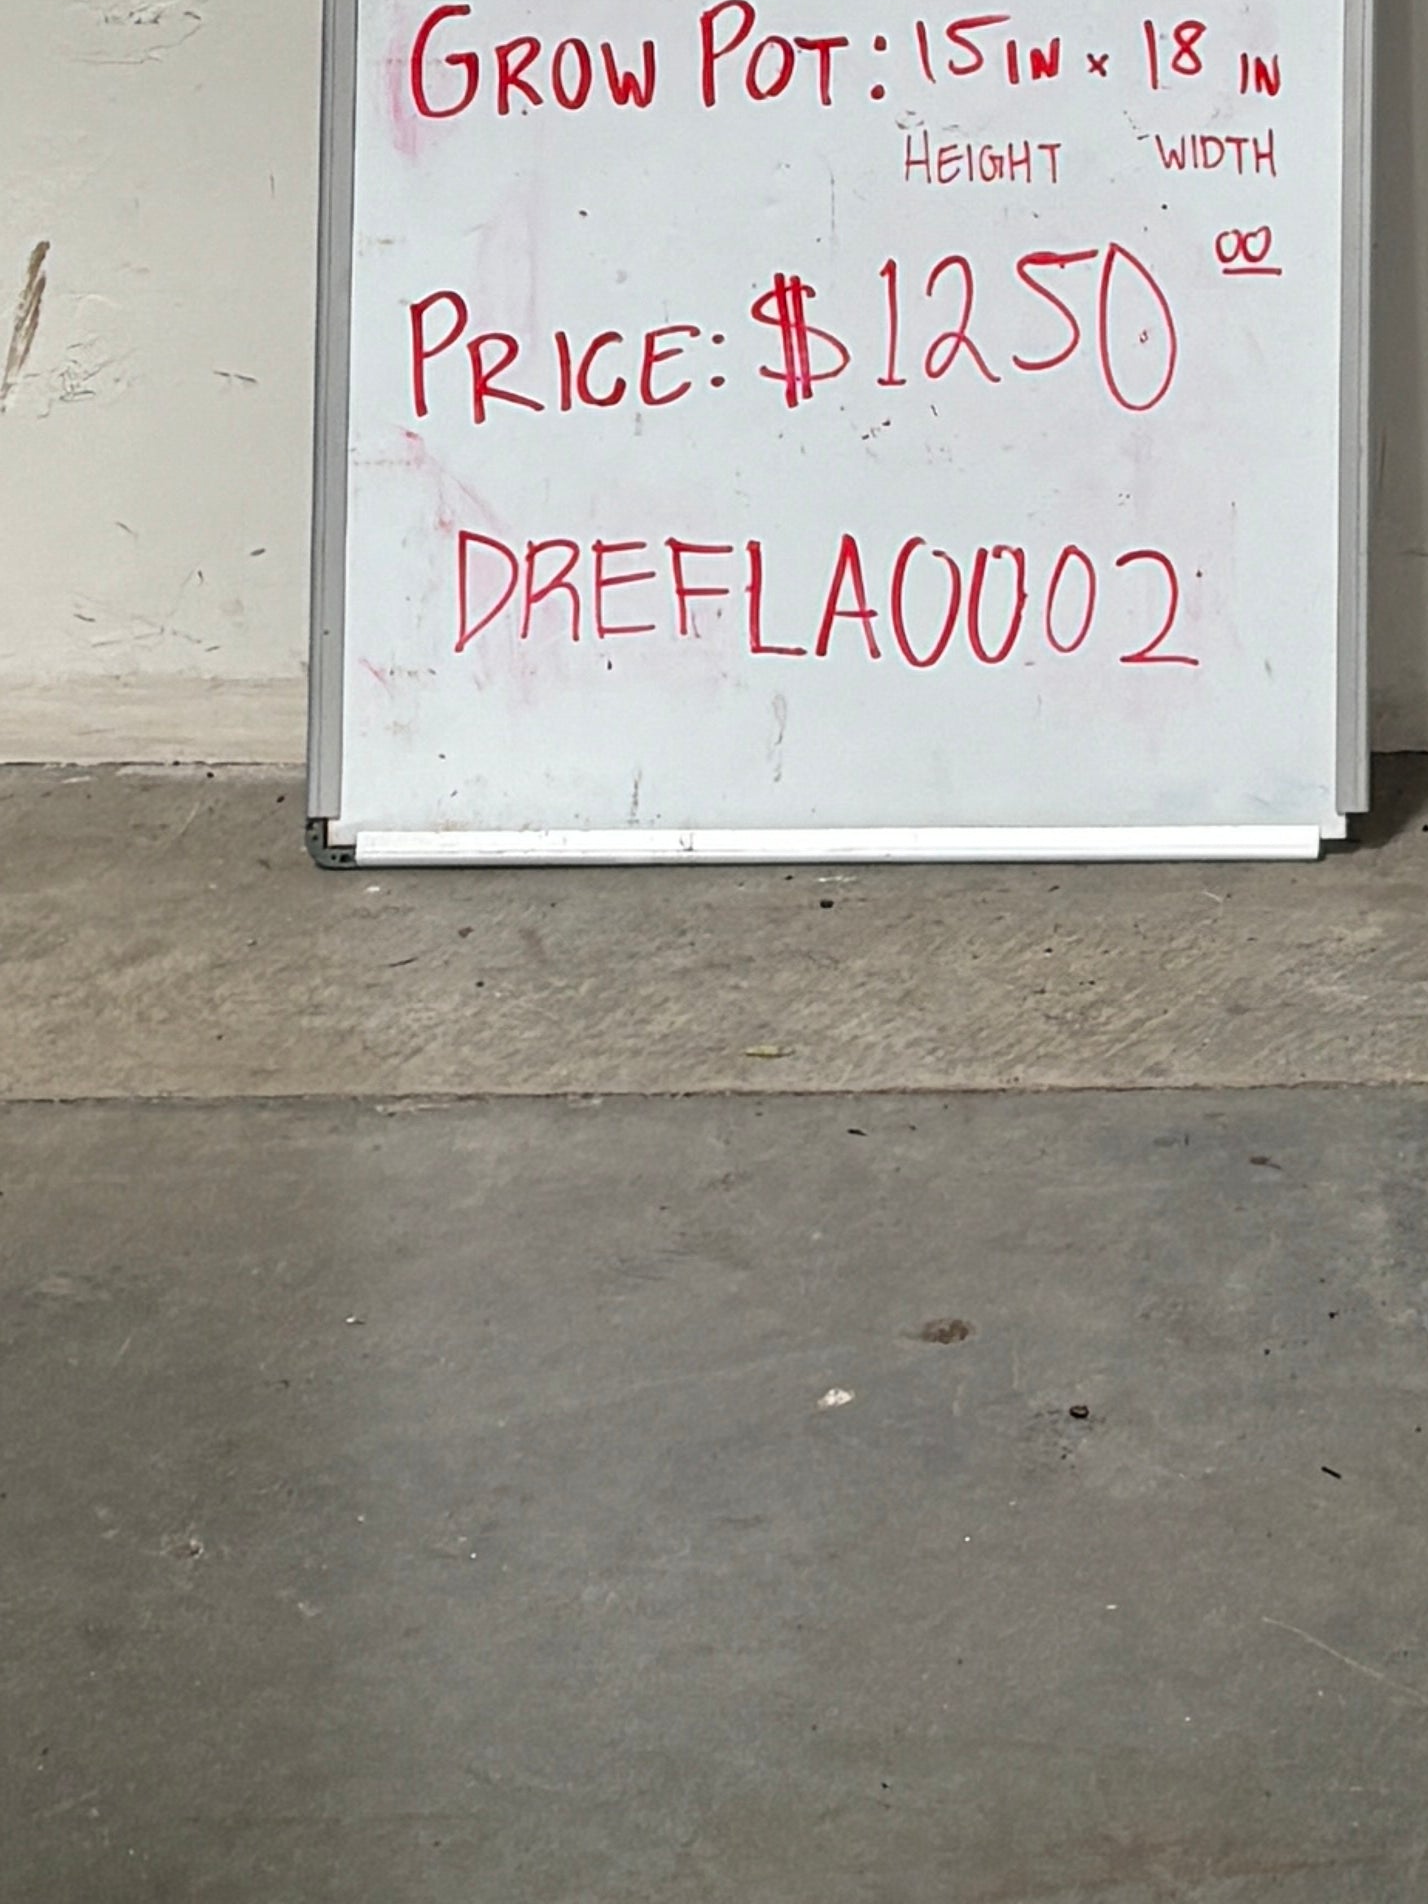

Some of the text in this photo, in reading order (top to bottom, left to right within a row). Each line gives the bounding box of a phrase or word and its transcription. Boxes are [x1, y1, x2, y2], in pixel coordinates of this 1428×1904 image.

[408, 3, 657, 120] GROW
[1142, 19, 1208, 90] 18
[1238, 51, 1282, 98] IN
[905, 130, 1277, 184] HEIGHT WIDTH
[408, 290, 726, 425] PRICE:
